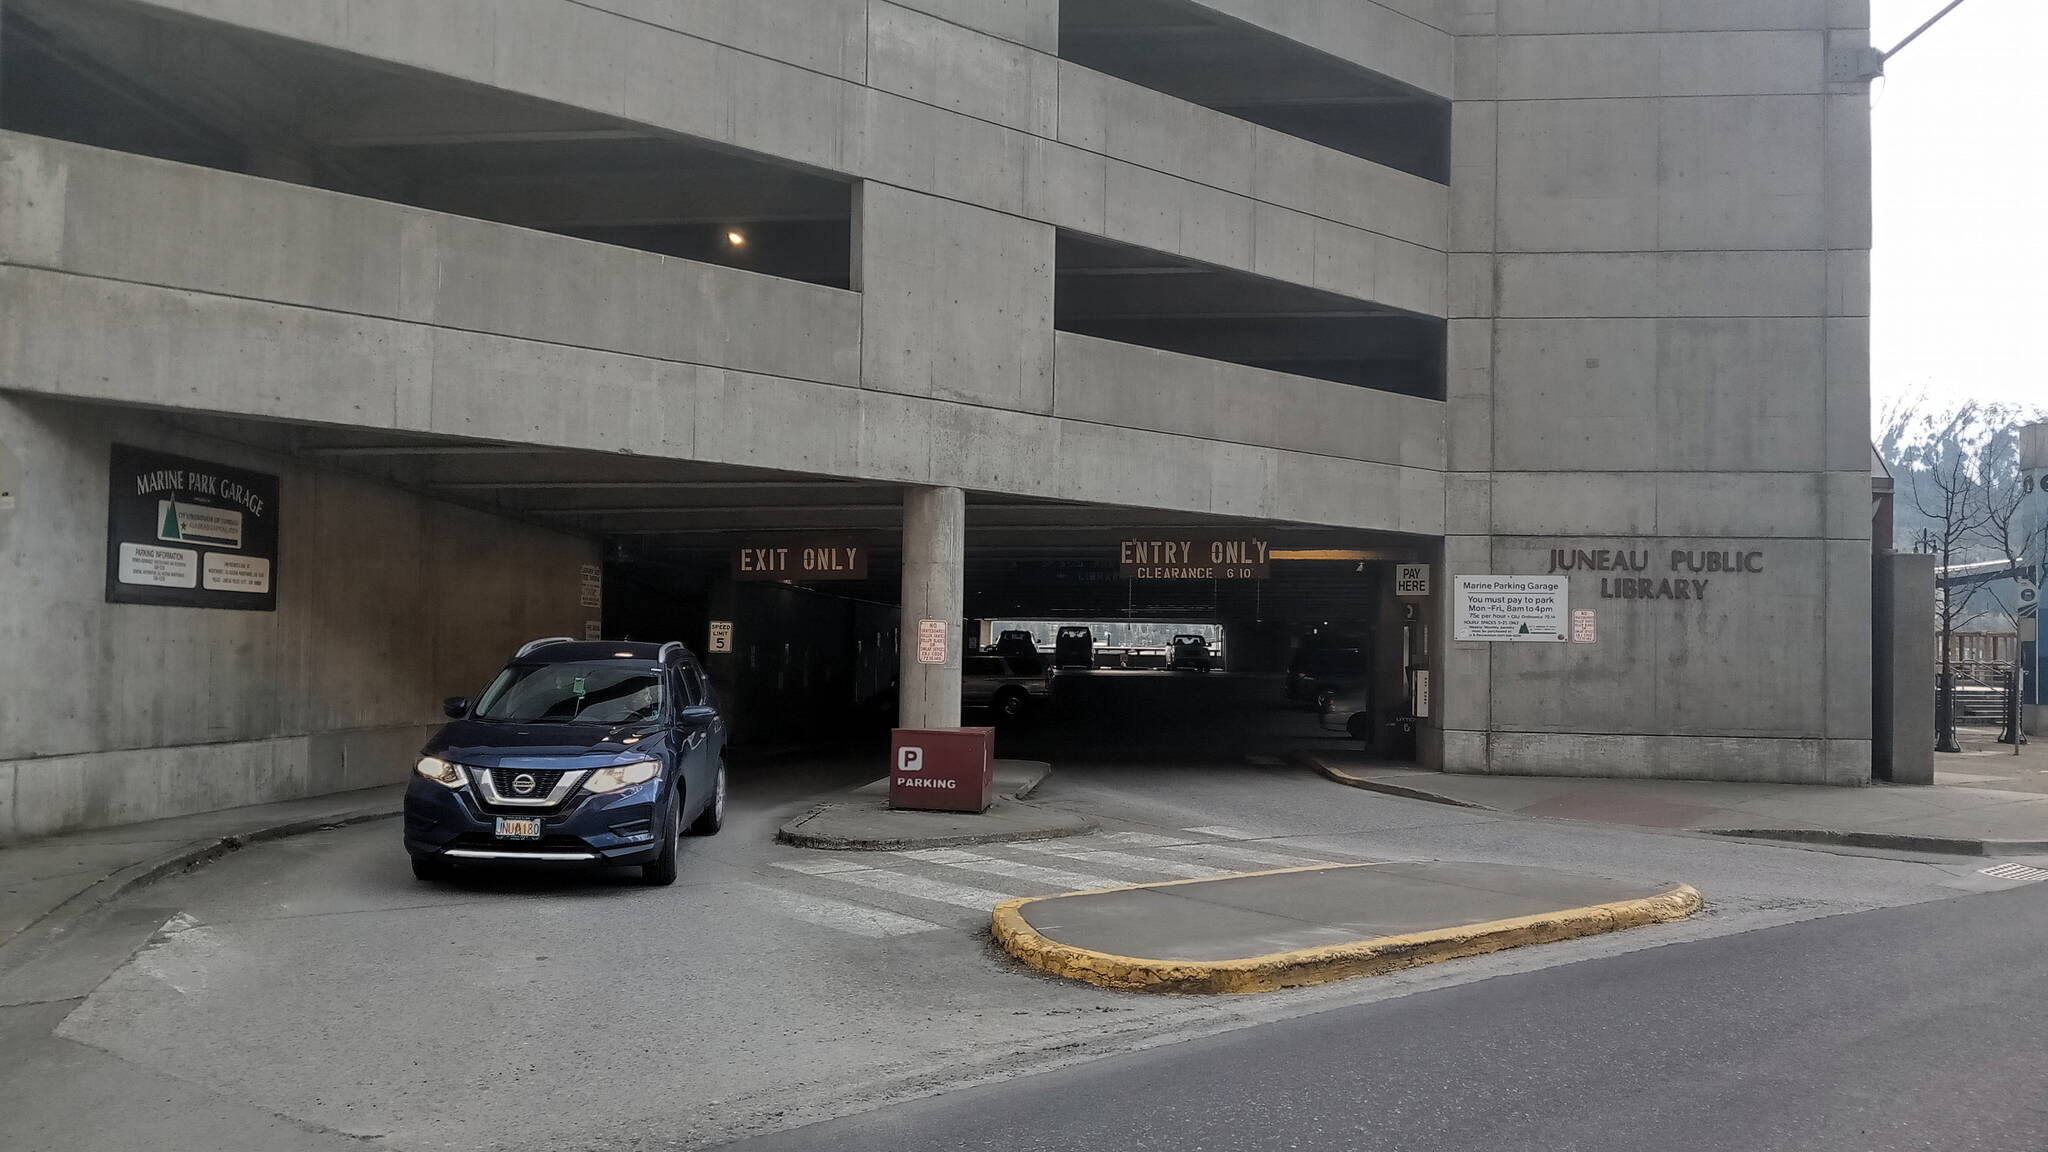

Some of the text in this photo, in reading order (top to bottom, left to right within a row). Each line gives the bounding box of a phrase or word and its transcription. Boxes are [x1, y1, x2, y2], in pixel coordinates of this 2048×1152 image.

[136, 470, 264, 518] MARINE PARK GARAGE
[1121, 541, 1267, 564] ENTRY ONLY
[741, 547, 857, 571] EXIT ONLY
[1548, 549, 1763, 574] JUNEAU PUBLIC
[1137, 567, 1213, 579] CLEARANCE
[1403, 568, 1421, 579] PAY
[1398, 580, 1426, 592] HERE
[1463, 581, 1559, 591] Marine Parking Garage
[1600, 578, 1709, 600] LIBRARY
[1467, 595, 1485, 603] You
[1507, 597, 1522, 605] pay
[1535, 597, 1554, 605] park
[1535, 605, 1553, 613] 4pm
[716, 637, 725, 649] 5
[897, 777, 956, 789] PARKING
